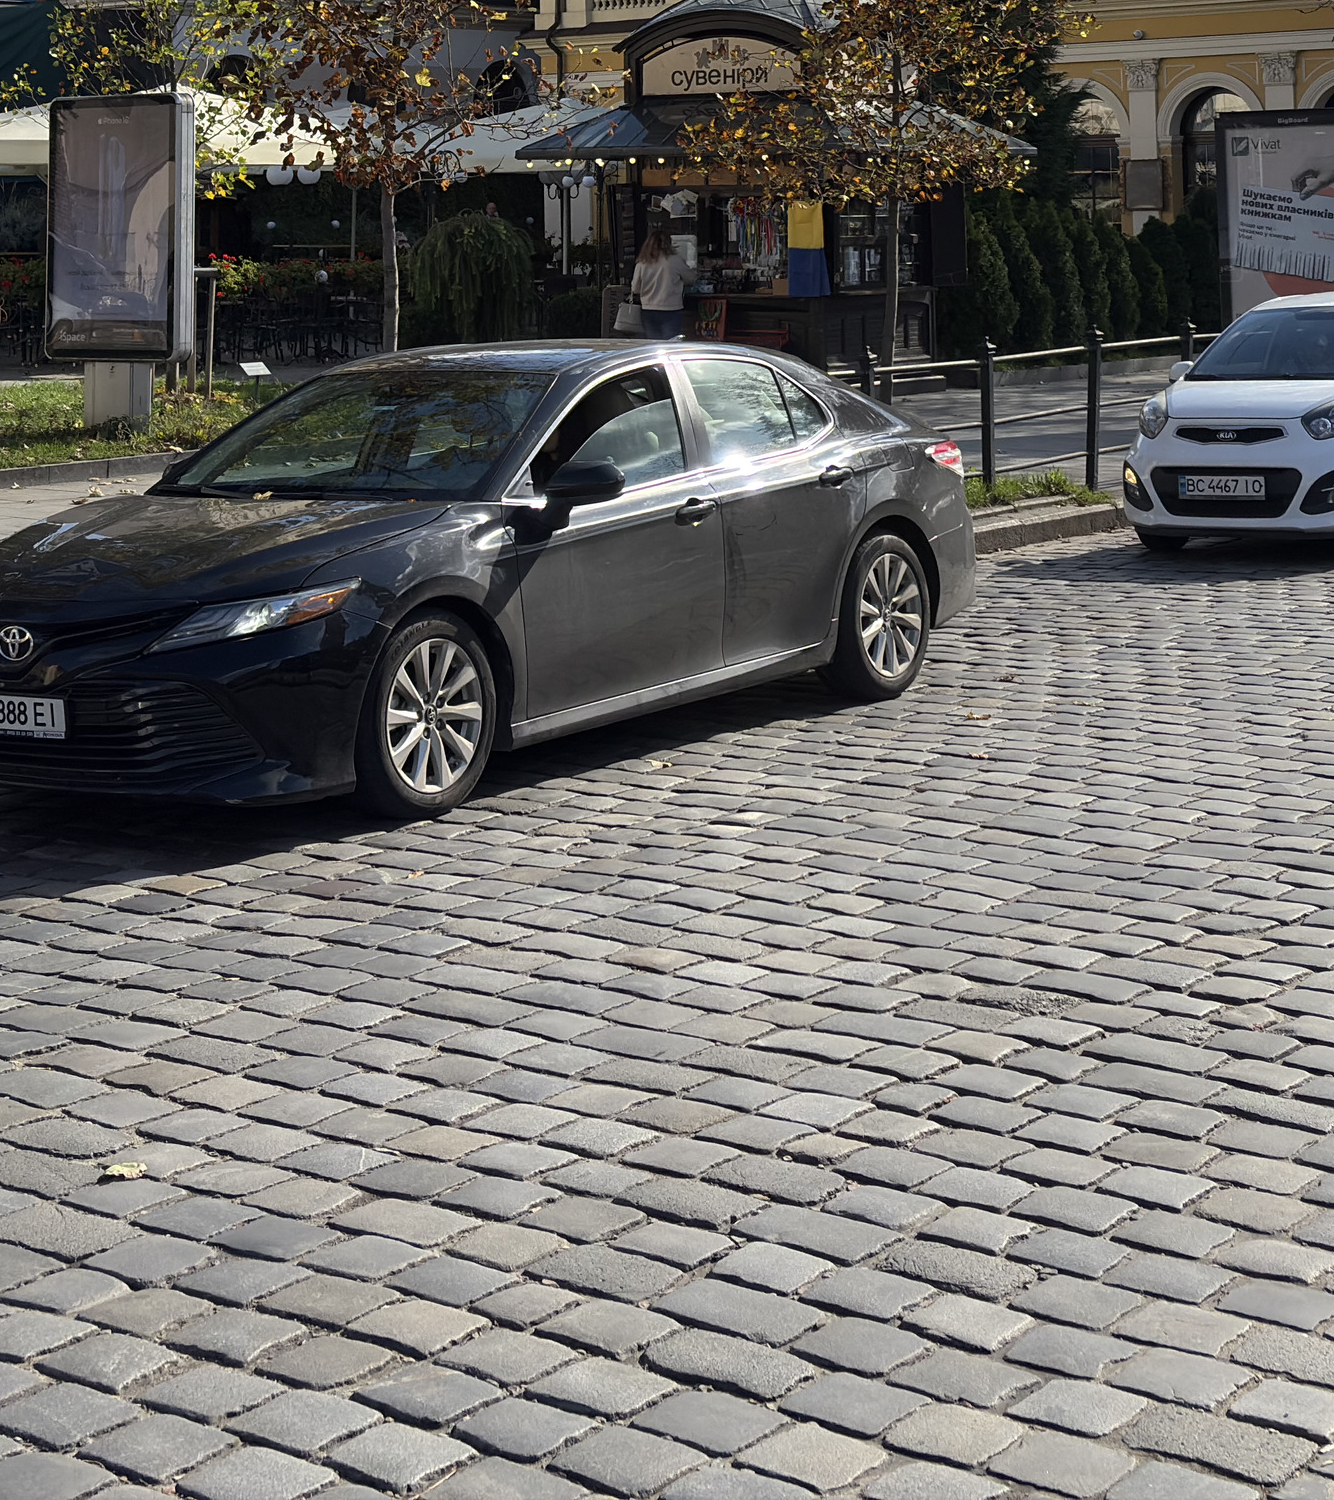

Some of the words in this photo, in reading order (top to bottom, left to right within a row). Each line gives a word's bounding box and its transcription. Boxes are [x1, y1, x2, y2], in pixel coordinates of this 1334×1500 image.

[1251, 138, 1282, 150] Vivat
[1243, 189, 1293, 204] Шукаємо
[1240, 208, 1292, 223] книжкам
[1241, 200, 1275, 211] нових
[1277, 205, 1334, 220] власників
[59, 329, 86, 343] iSpace
[1187, 479, 1205, 492] BC
[1208, 479, 1239, 493] 4467
[33, 702, 55, 727] EI
